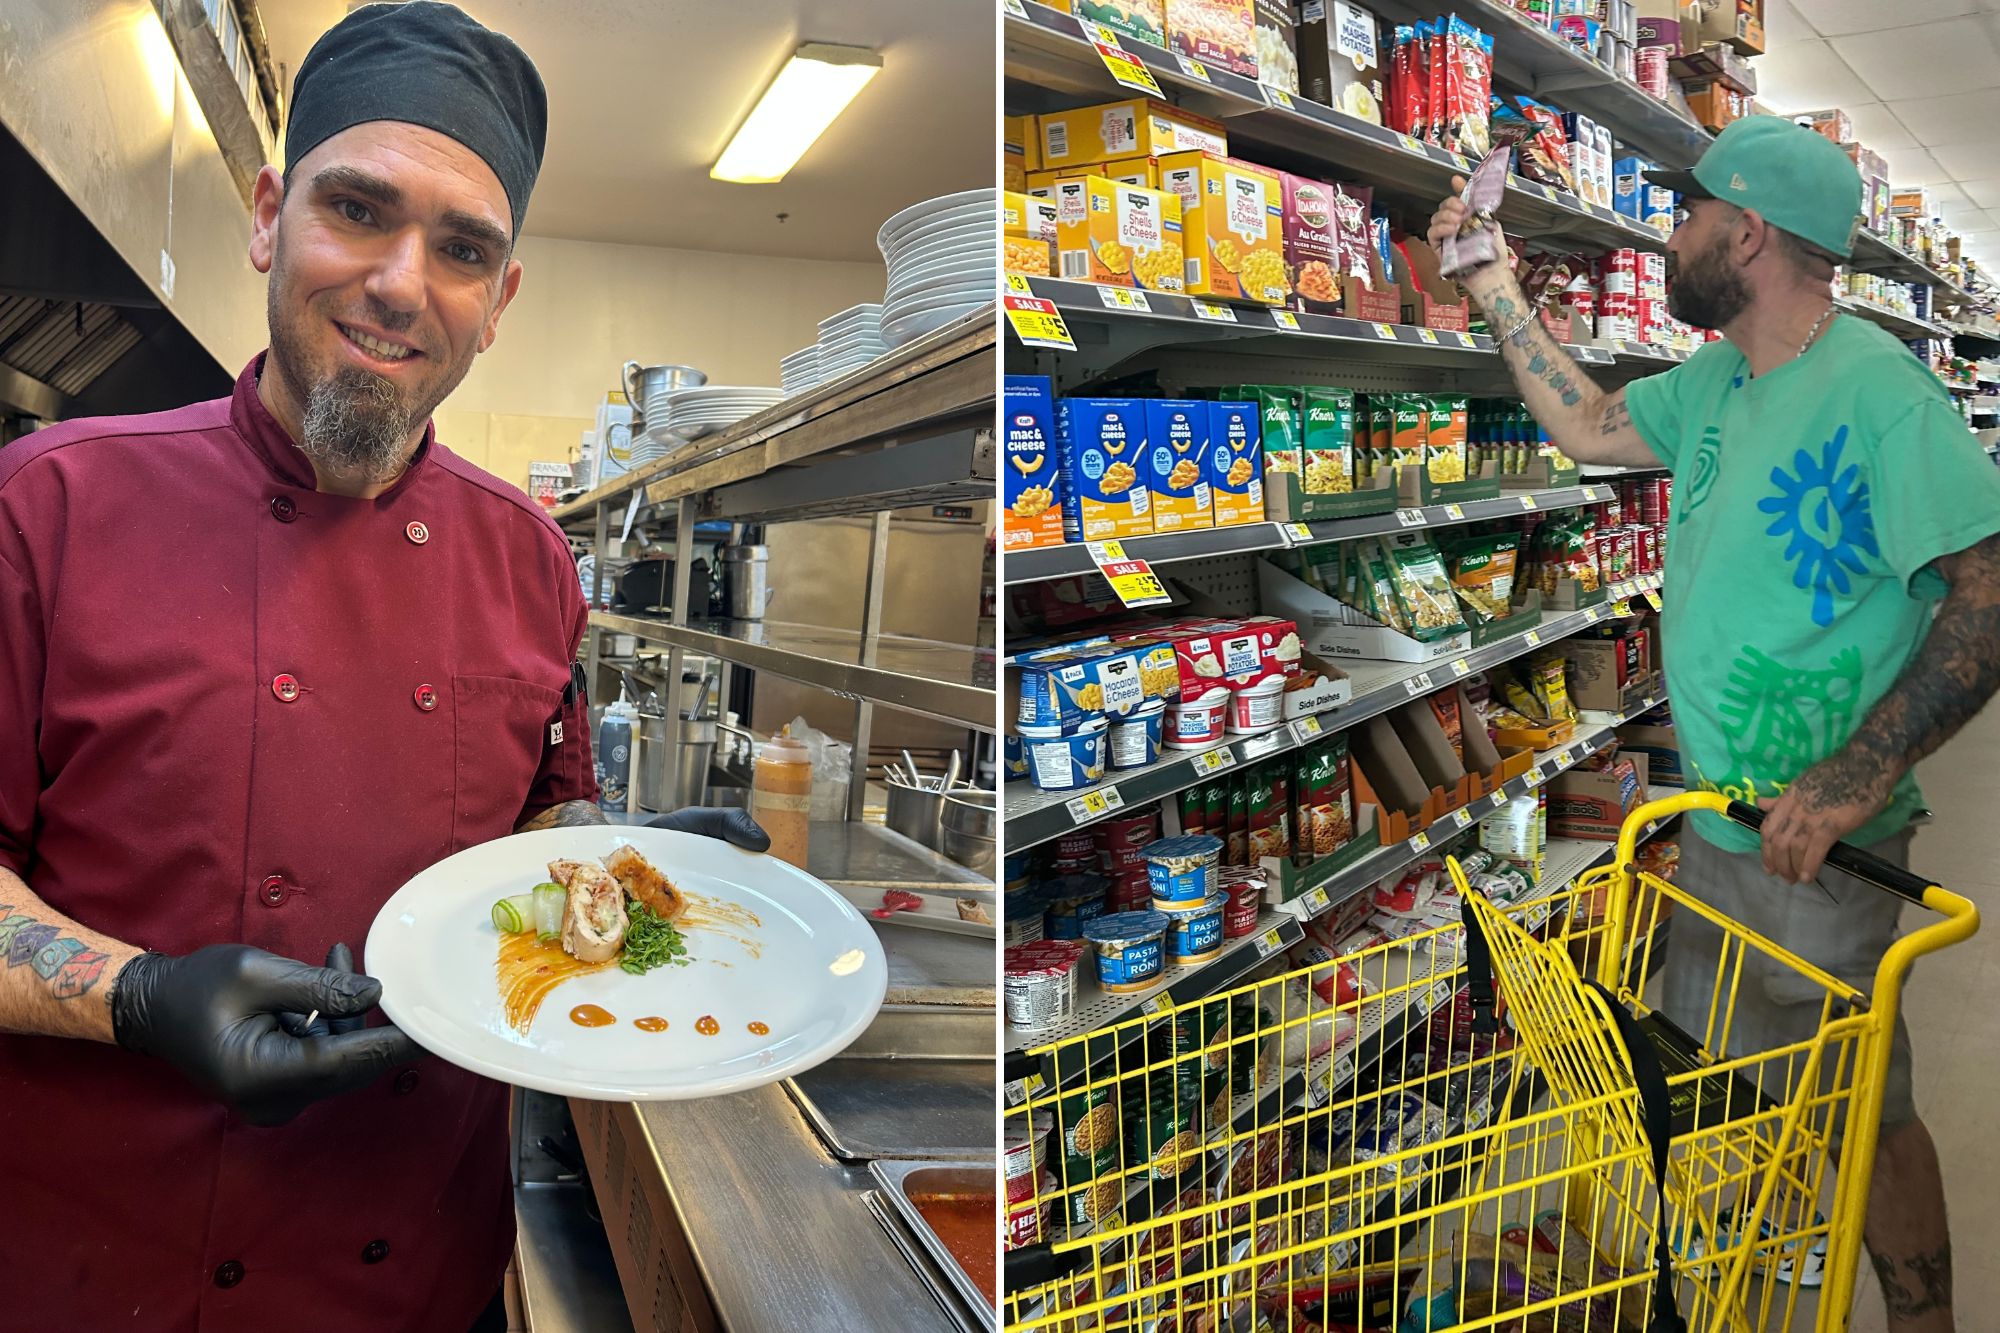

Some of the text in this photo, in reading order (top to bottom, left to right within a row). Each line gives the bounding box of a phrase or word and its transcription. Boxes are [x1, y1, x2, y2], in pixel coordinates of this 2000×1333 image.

[1110, 15, 1137, 31] BROCCOLI
[1342, 24, 1371, 45] MASHED
[1340, 34, 1374, 58] POTATOES
[1106, 47, 1133, 62] SALE
[1236, 200, 1258, 215] Shells
[1298, 199, 1329, 213] IDAHOAN
[1129, 213, 1152, 228] Shells
[1237, 213, 1263, 228] Cheese
[1129, 227, 1158, 241] Cheese
[1299, 228, 1332, 243] Au Gratin
[1014, 298, 1045, 311] SALE
[1038, 316, 1046, 326] 2
[1044, 326, 1055, 335] for
[1309, 407, 1336, 422] Knorr
[1397, 411, 1419, 422] Knorr
[1430, 411, 1451, 422] Knorr
[1171, 423, 1184, 431] mac
[1010, 430, 1032, 440] mac
[531, 463, 569, 473] FRANZIA
[1460, 554, 1490, 566] Knorr
[1113, 563, 1140, 575] SALE
[1136, 577, 1143, 585] 2
[1141, 585, 1151, 593] for
[1197, 643, 1209, 651] PACK
[1320, 644, 1361, 655] Side Dishes
[1228, 658, 1256, 670] POTATOES
[1230, 653, 1252, 662] MASHED
[1065, 670, 1082, 679] 4 PACK
[1104, 675, 1138, 693] Macaroni
[1112, 687, 1140, 702] Cheese
[1298, 692, 1340, 711] Side Dishes
[1194, 919, 1219, 932] PASTA
[1195, 932, 1219, 946] RONI
[1129, 945, 1158, 960] PASTA
[1131, 958, 1158, 975] RONI
